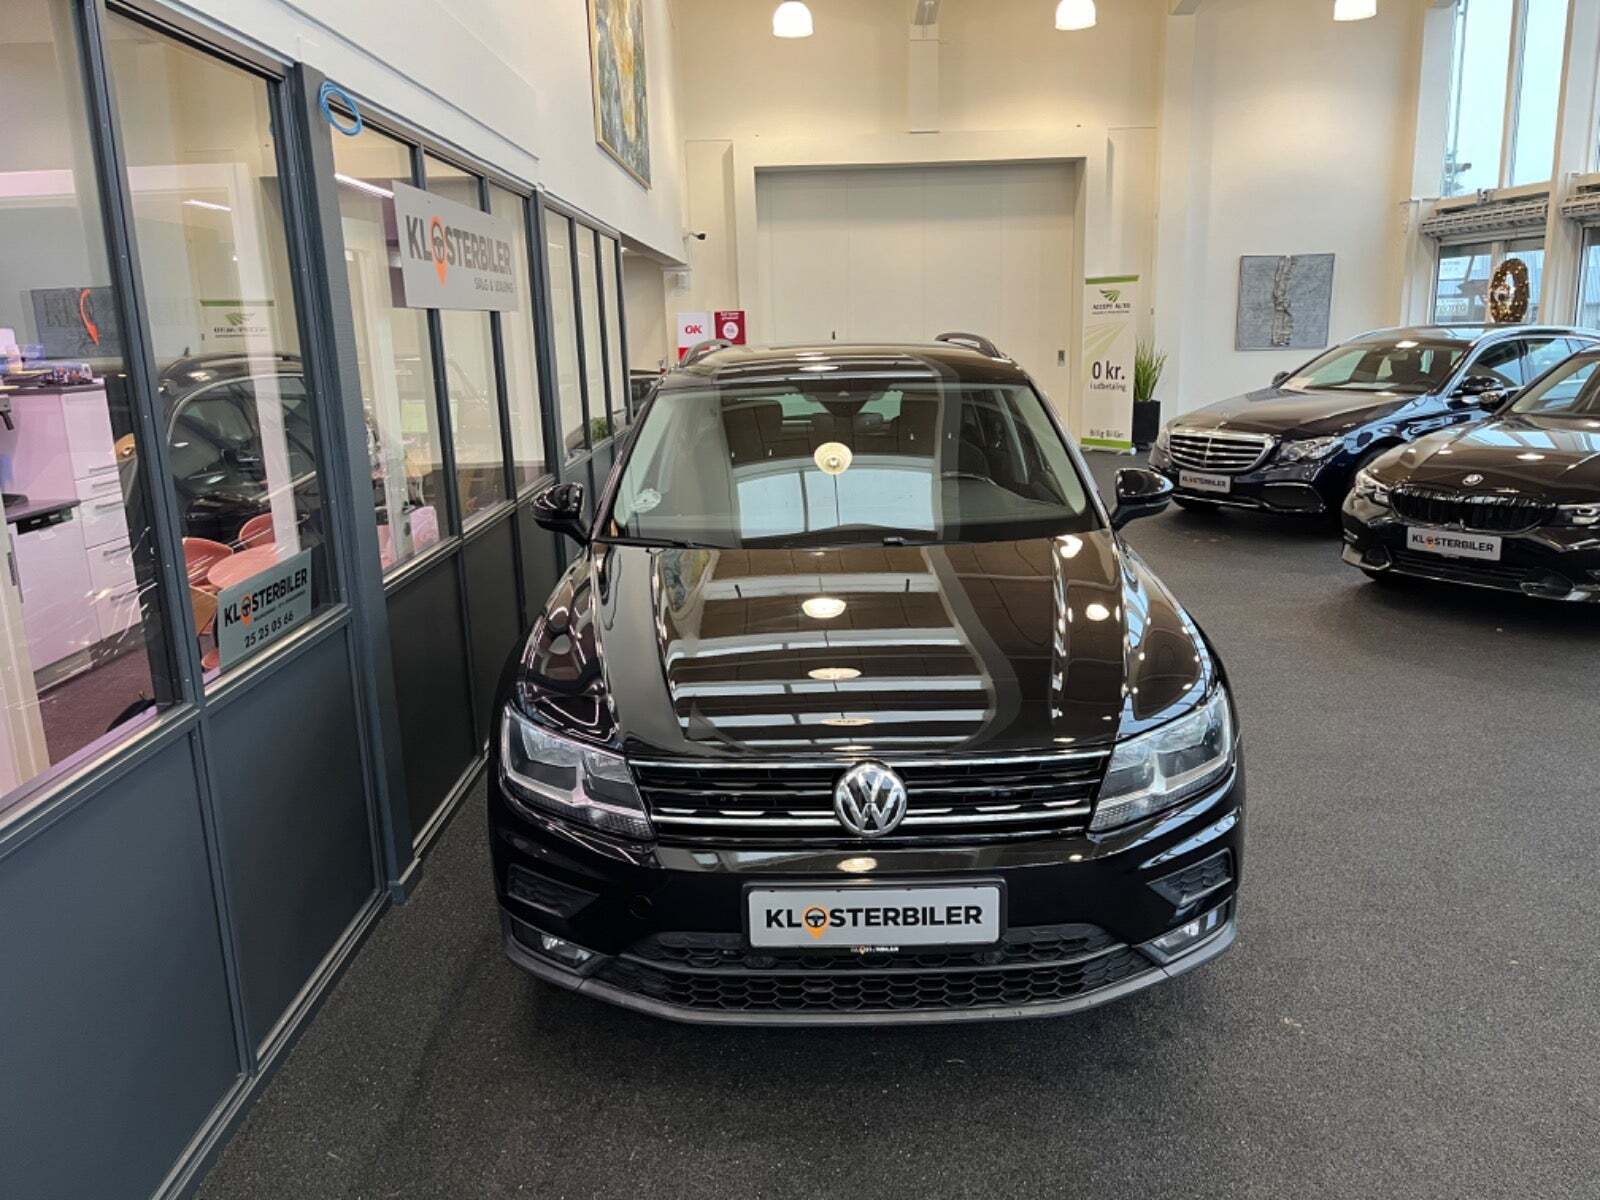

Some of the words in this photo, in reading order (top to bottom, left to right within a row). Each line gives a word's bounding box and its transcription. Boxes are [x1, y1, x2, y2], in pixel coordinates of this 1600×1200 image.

[405, 214, 513, 277] KLOSTERBILER
[684, 324, 703, 335] OK
[1092, 360, 1102, 380] 0
[1106, 360, 1126, 380] kr.
[1411, 533, 1495, 553] KLOSTERBILER
[223, 567, 308, 629] KLOSTERBILER
[765, 905, 983, 930] KLOSTERBILER
